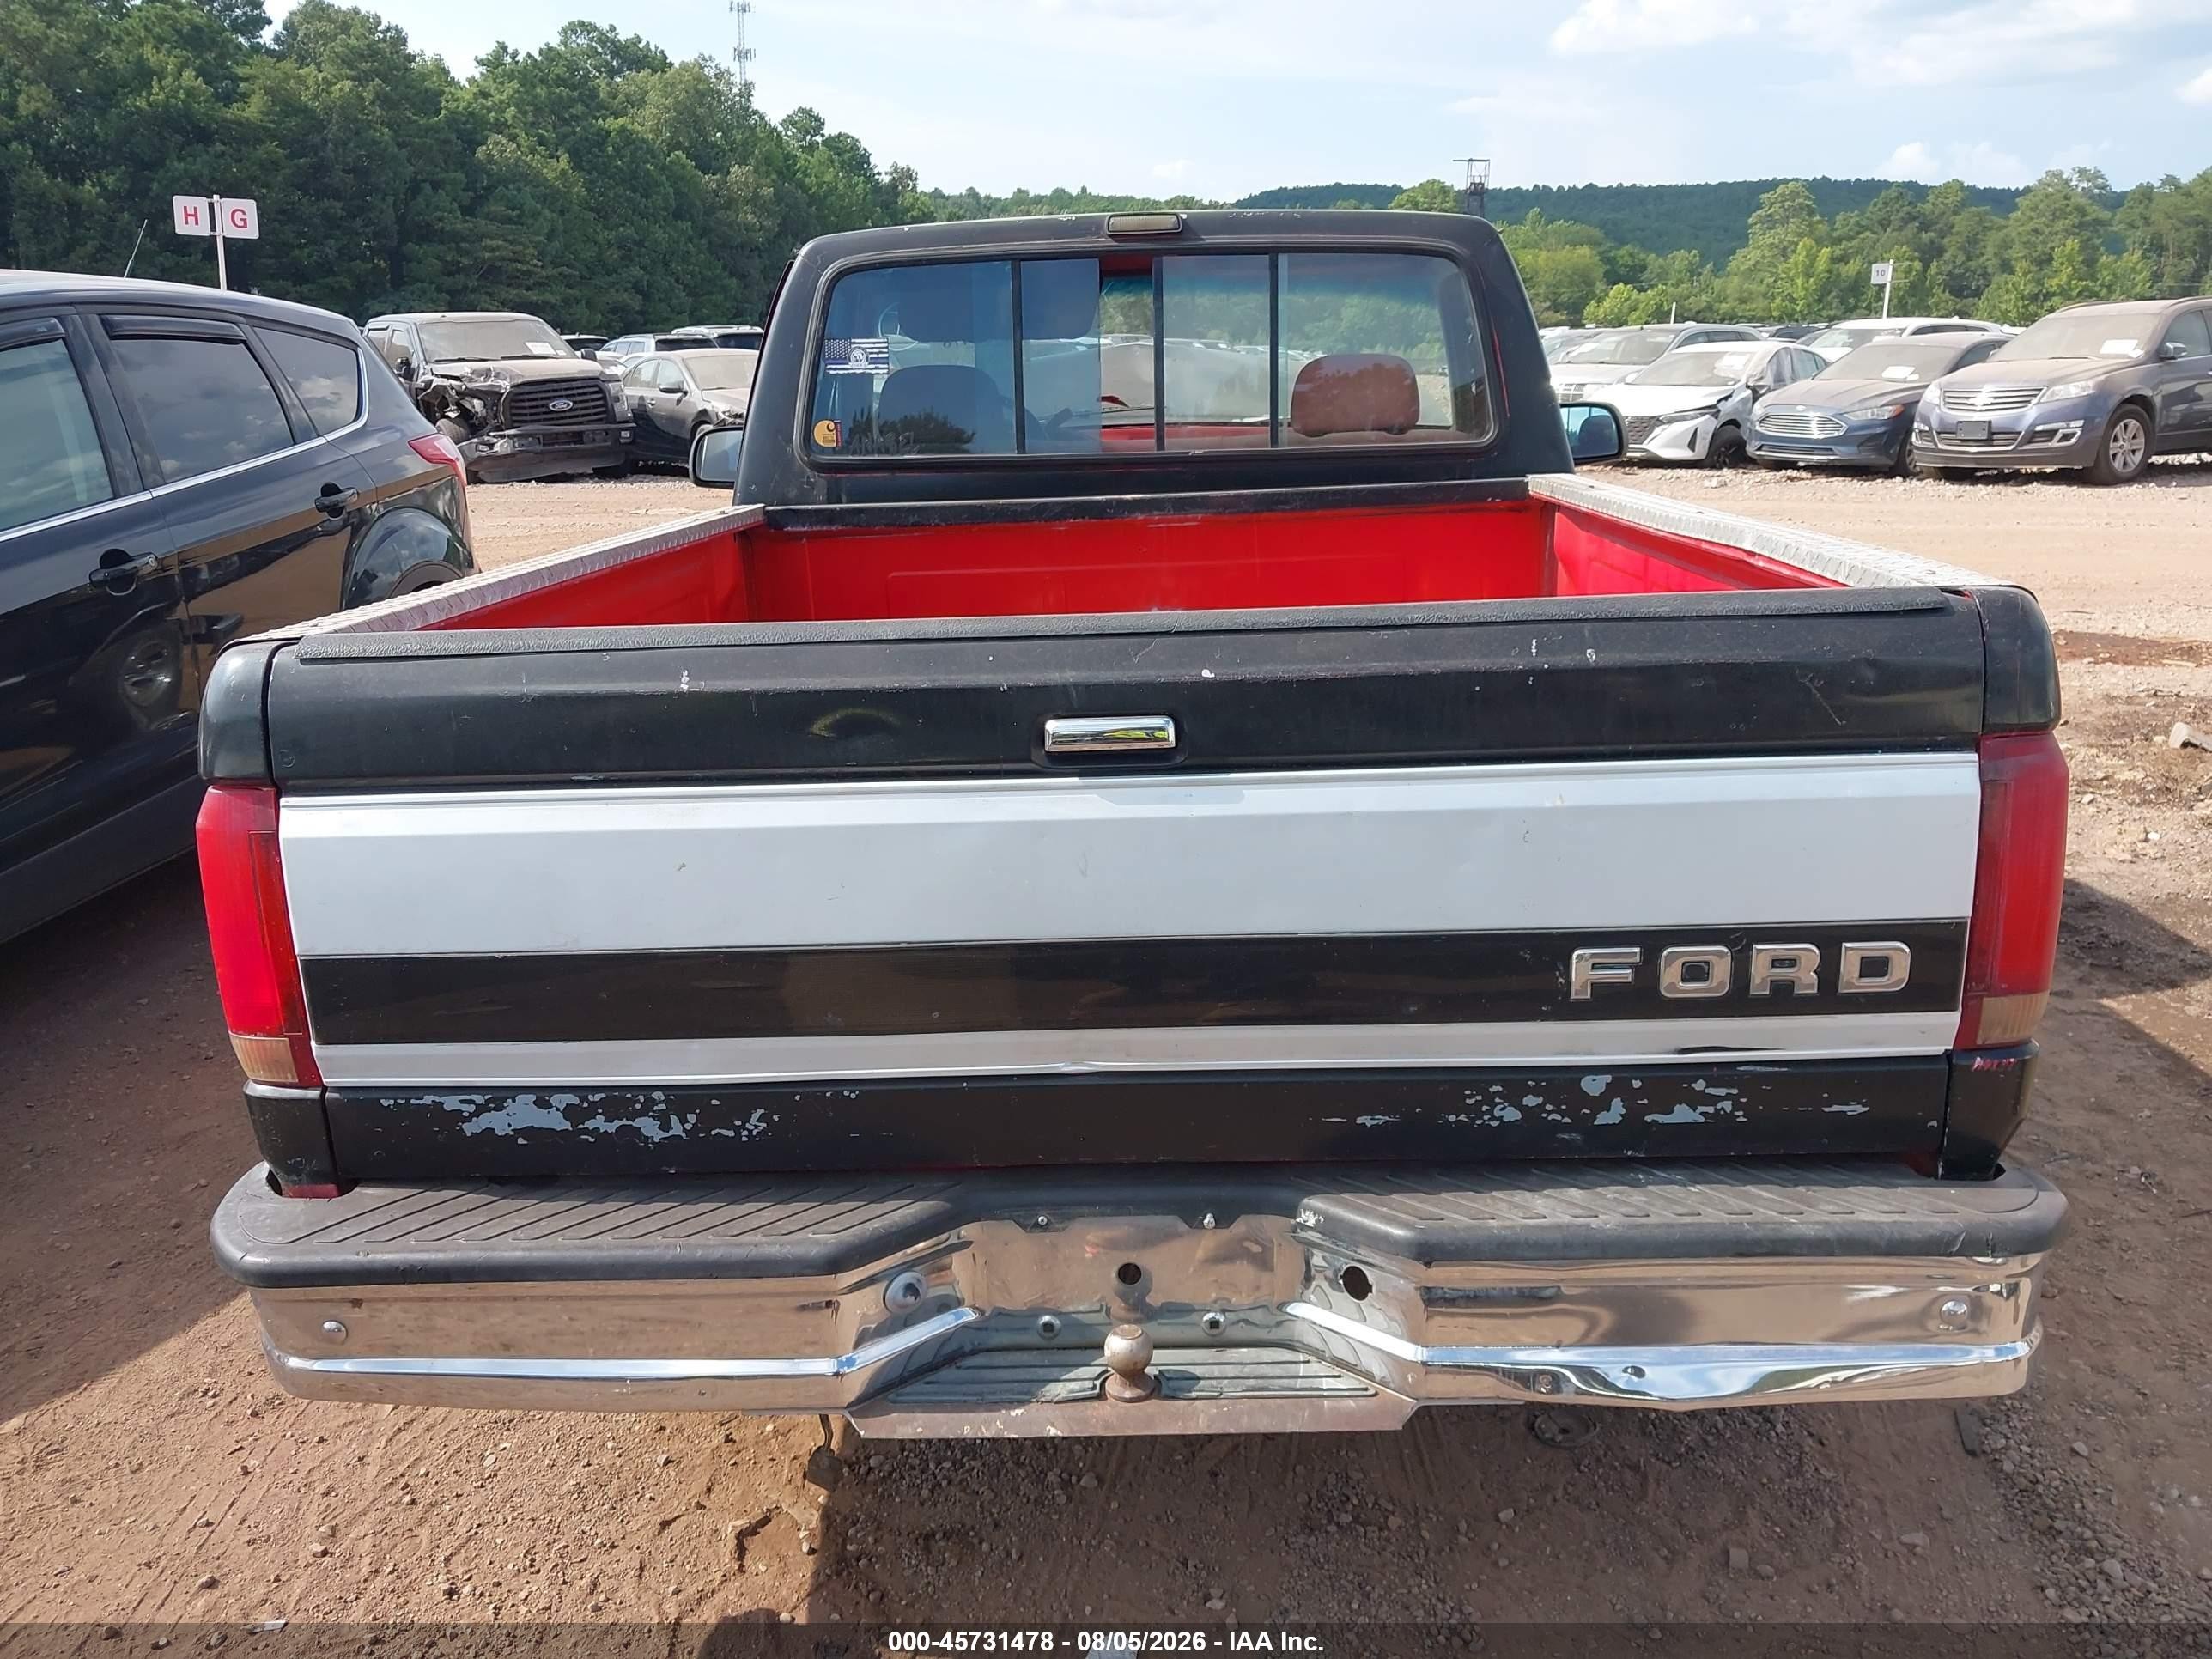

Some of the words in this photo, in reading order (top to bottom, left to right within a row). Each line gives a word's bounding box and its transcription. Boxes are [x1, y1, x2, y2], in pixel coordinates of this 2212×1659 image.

[184, 206, 199, 226] H
[230, 209, 248, 229] G
[1570, 940, 1912, 1000] FORD
